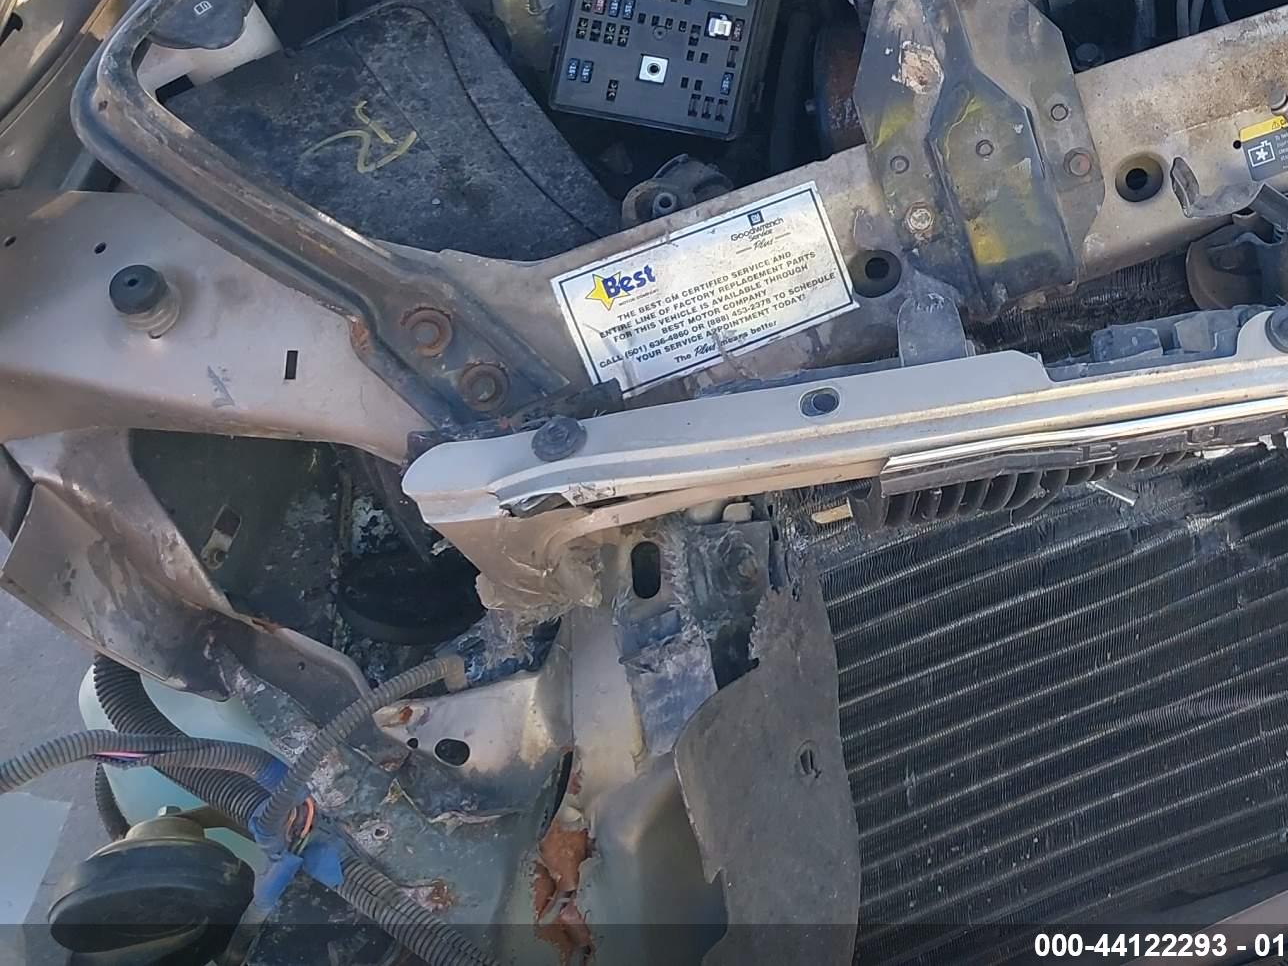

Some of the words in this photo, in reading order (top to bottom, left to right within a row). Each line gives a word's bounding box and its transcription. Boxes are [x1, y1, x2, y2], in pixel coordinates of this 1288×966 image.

[730, 217, 784, 242] Goodwrench
[748, 228, 773, 242] Service
[600, 322, 633, 338] ENTIRE
[634, 312, 657, 326] LINE
[658, 306, 670, 317] OF
[674, 289, 714, 310] FACTORY
[718, 264, 784, 294] REPLACEMENT
[786, 251, 816, 268] PARTS
[602, 264, 656, 298] Best
[613, 332, 632, 343] FOR
[634, 322, 656, 334] THIS
[658, 308, 698, 326] VEHICLE
[700, 302, 710, 310] IS
[712, 282, 760, 306] AVAILABLE
[764, 264, 808, 286] THROUGH
[618, 310, 635, 322] THE
[638, 300, 662, 314] BEST
[664, 293, 680, 304] GM
[682, 274, 728, 298] CERTIFIED
[731, 259, 770, 278] SERVICE
[773, 252, 792, 263] AND
[600, 354, 624, 368] CALL
[624, 344, 648, 360] (501)
[692, 323, 705, 332] OR
[707, 312, 730, 329] (888)
[732, 297, 772, 318] 453-2378
[773, 292, 786, 301] TO
[788, 272, 836, 294] SCHEDULE
[636, 349, 662, 362] YOUR
[664, 334, 704, 352] SERVICE
[706, 308, 770, 338] APPOINTMENT
[773, 293, 806, 311] TODAY!
[661, 320, 685, 334] BEST
[688, 306, 720, 324] MOTOR
[722, 290, 768, 312] COMPANY
[674, 354, 692, 363] The
[694, 342, 716, 357] Plus
[720, 331, 748, 346] means
[750, 320, 777, 334] better
